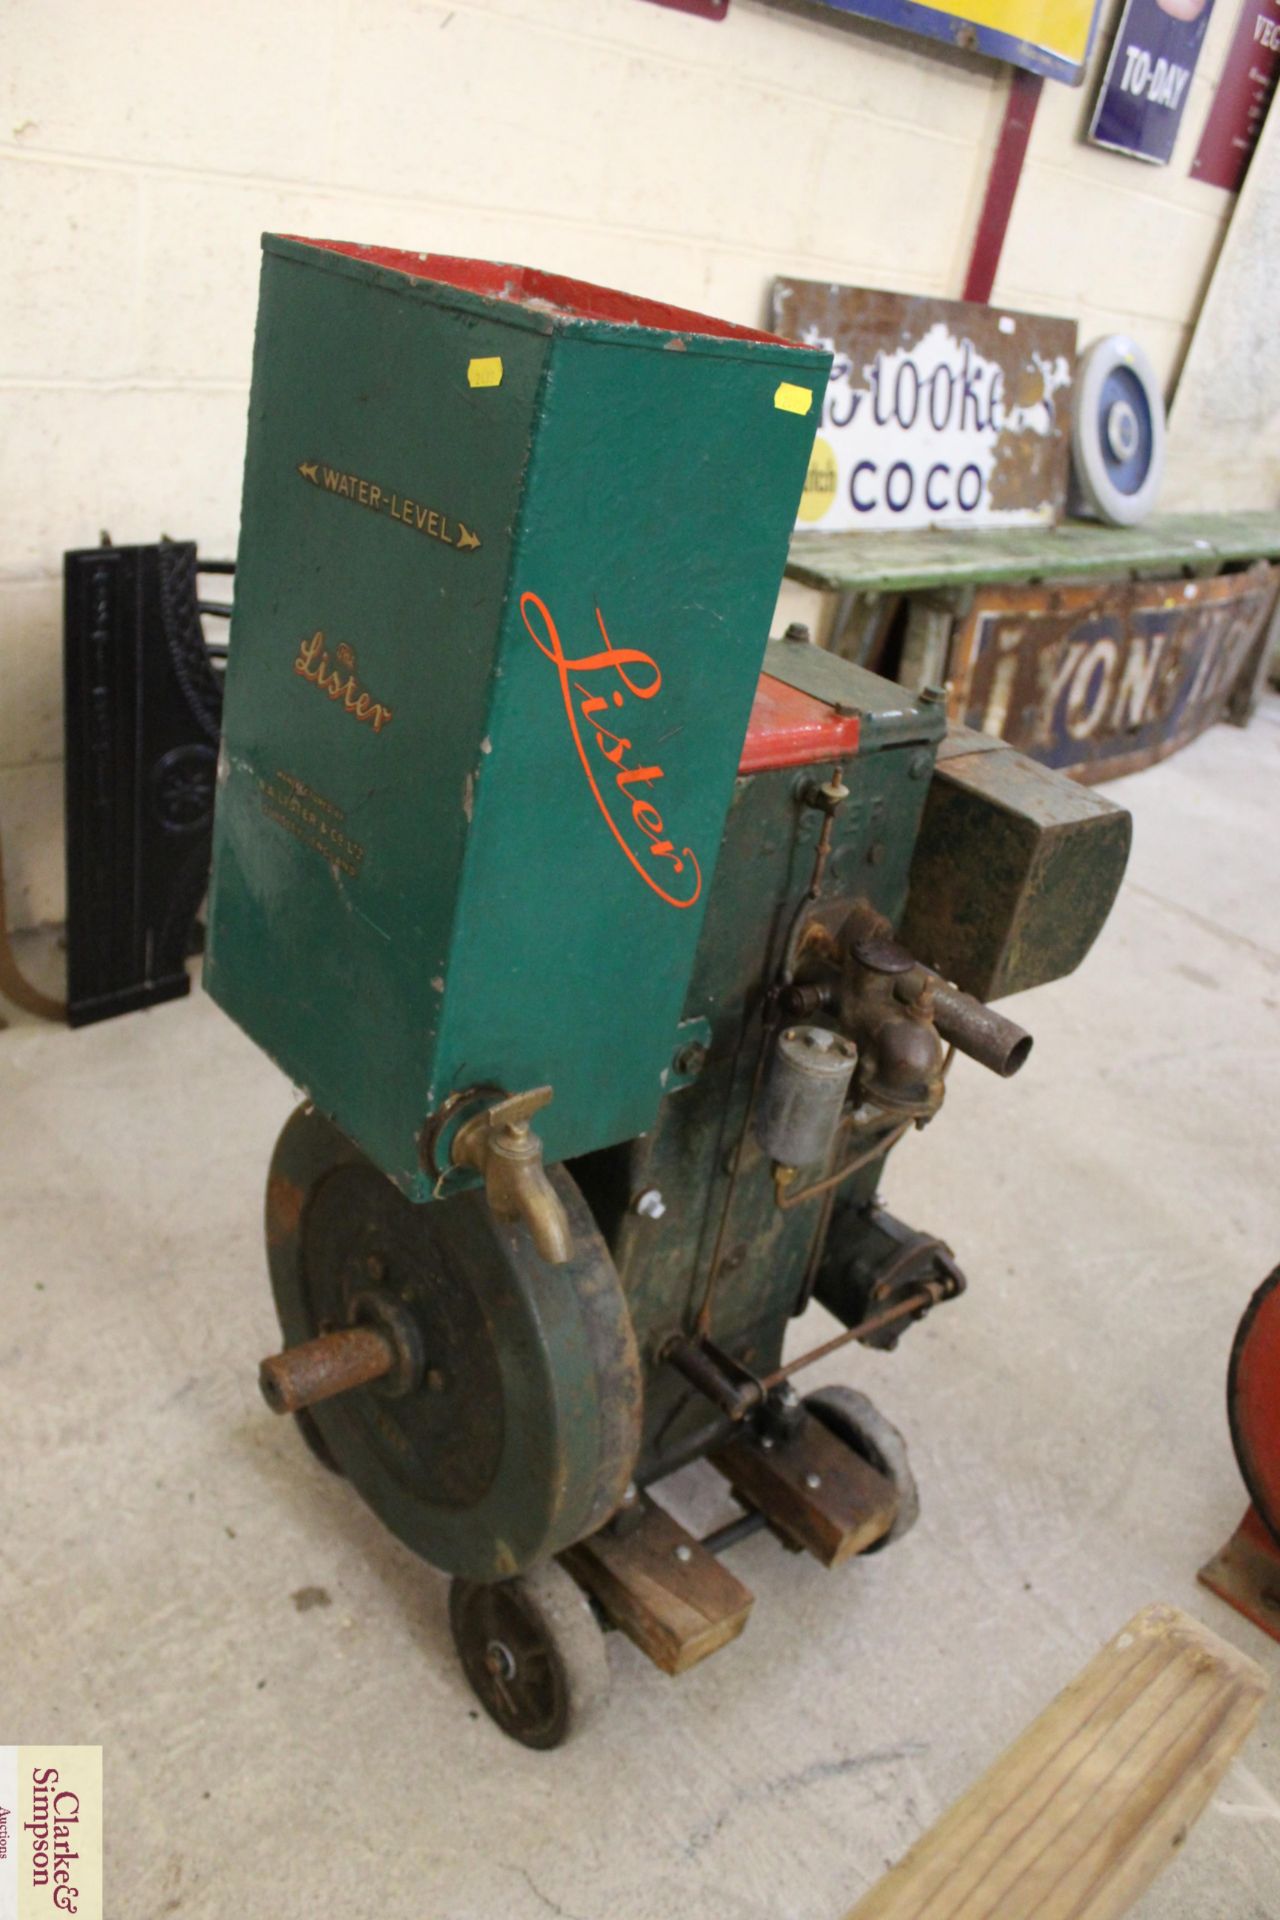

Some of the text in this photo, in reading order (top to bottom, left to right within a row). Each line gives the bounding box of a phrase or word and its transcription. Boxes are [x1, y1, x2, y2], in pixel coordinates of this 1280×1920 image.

[1120, 45, 1190, 110] TO-DAY
[323, 466, 453, 543] WATER-LEVEL
[295, 631, 392, 732] Lister
[520, 591, 701, 908] Lister
